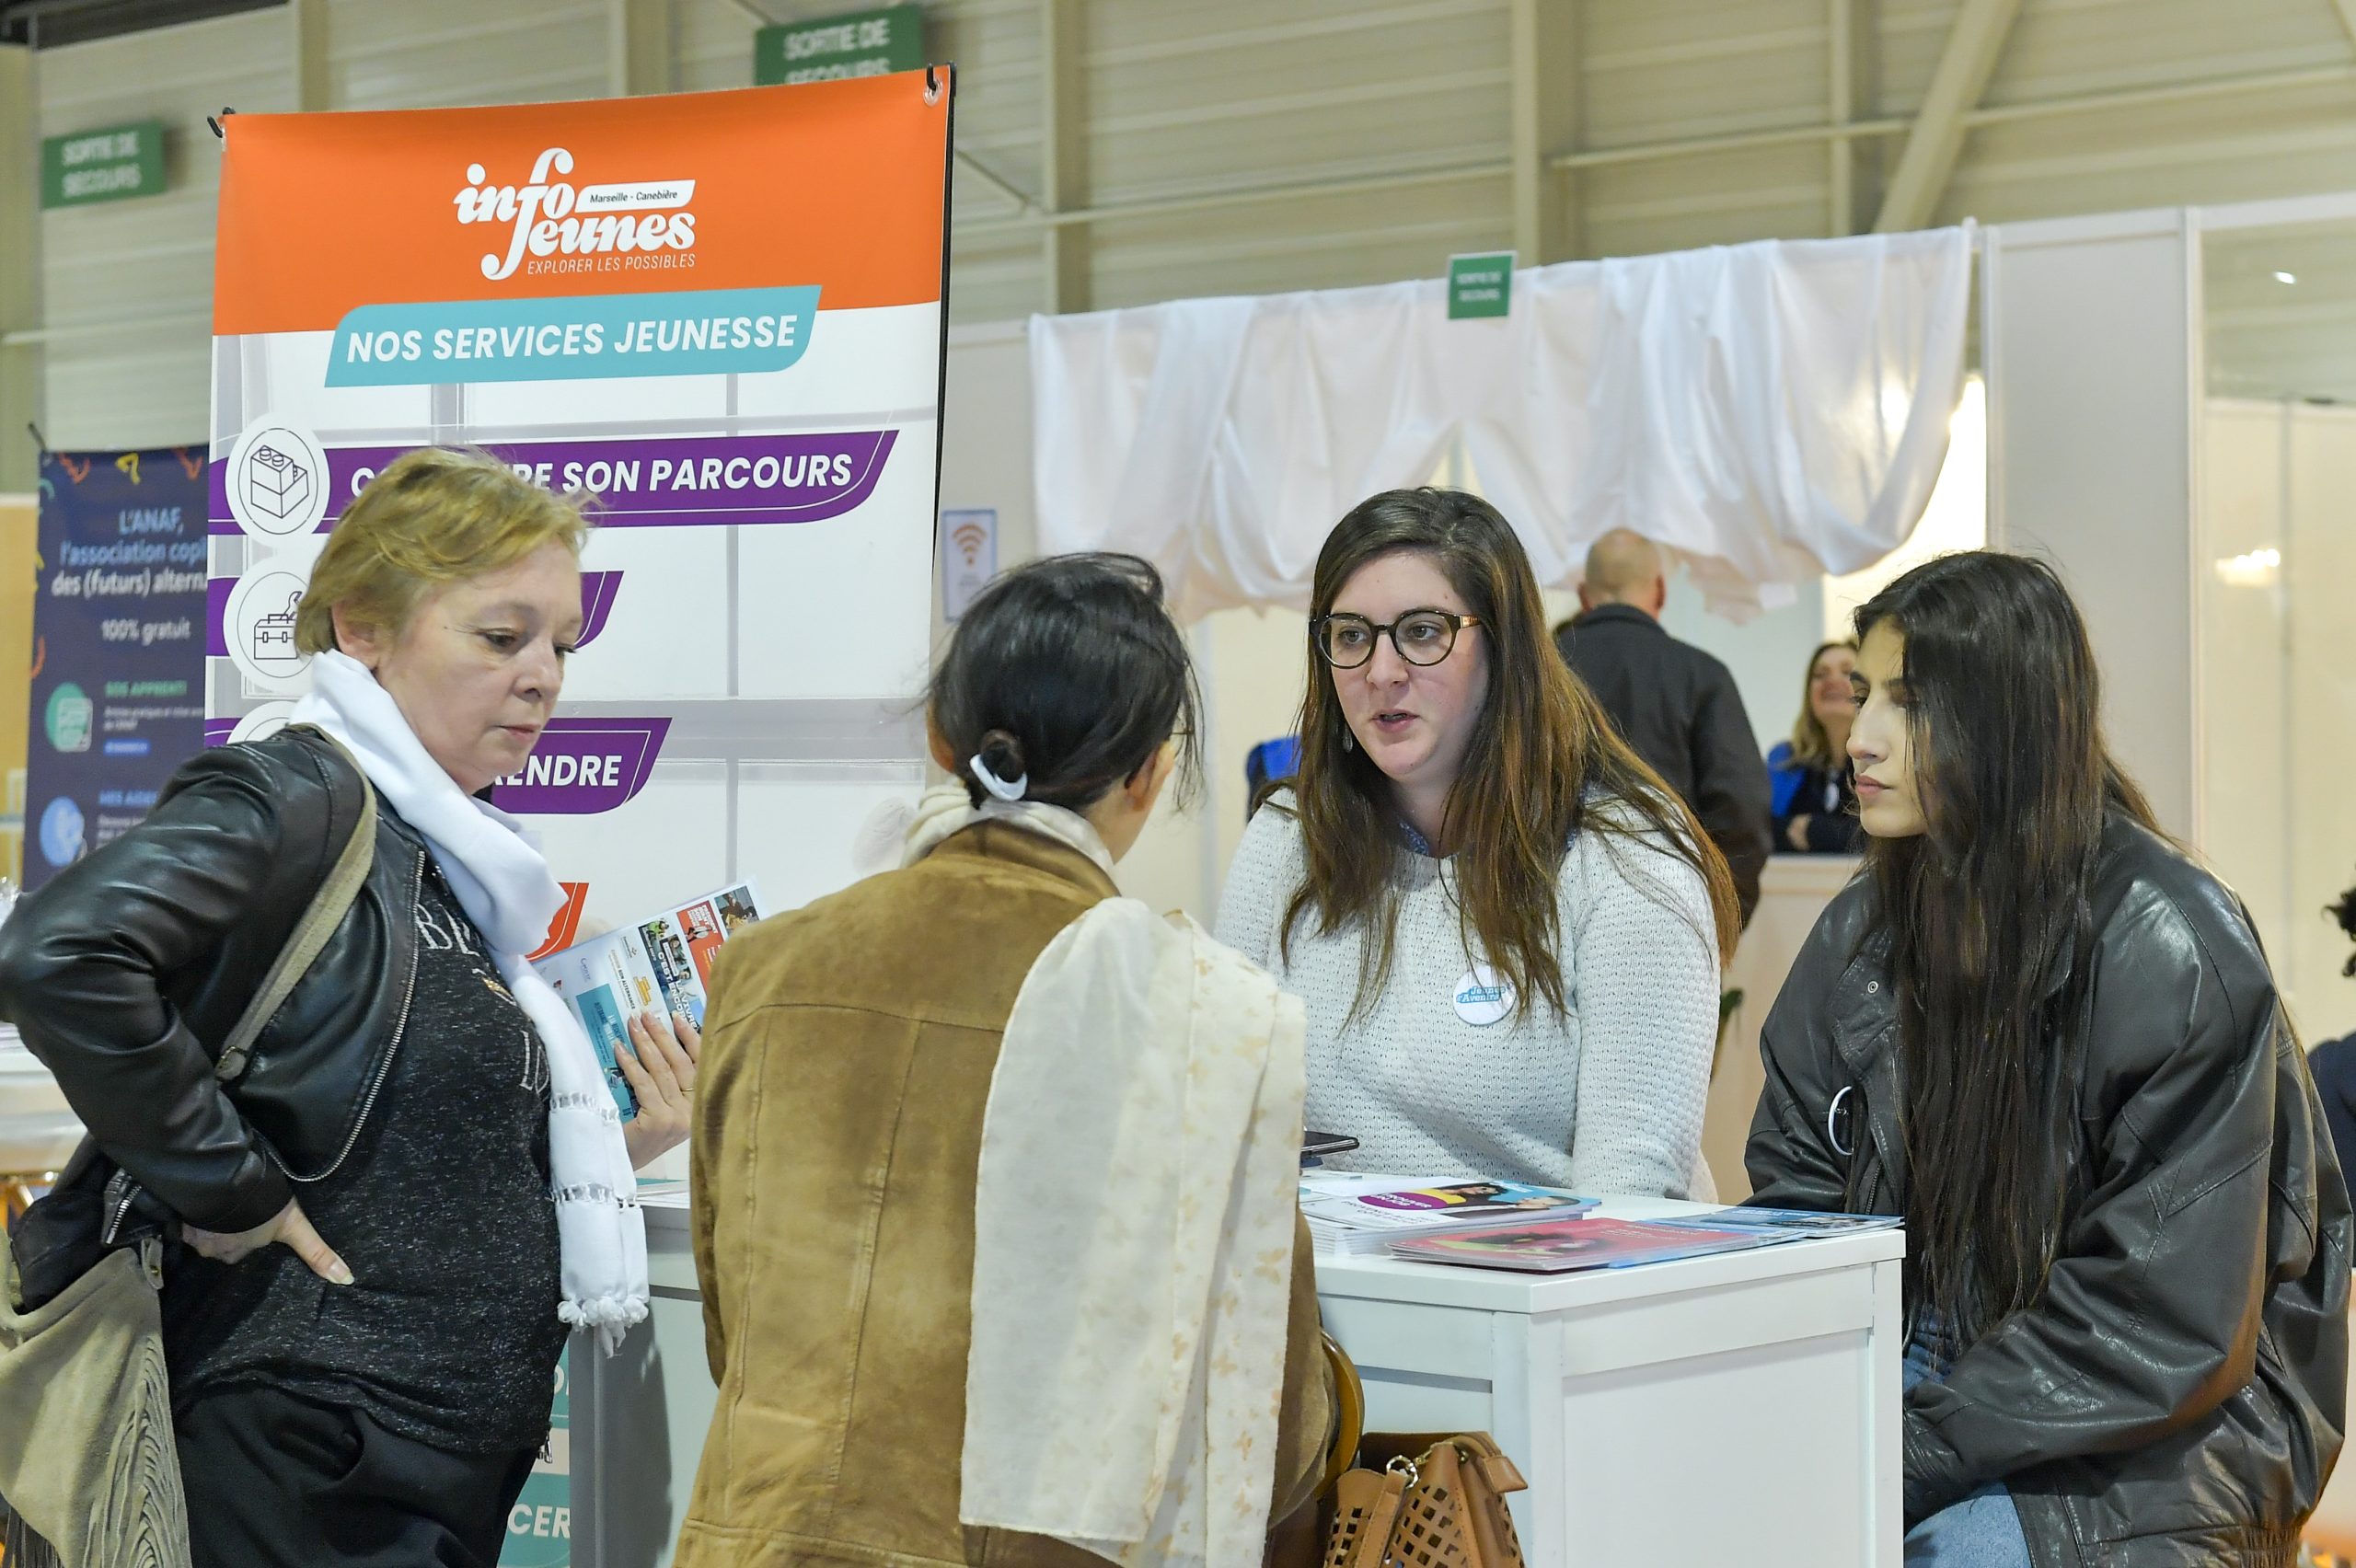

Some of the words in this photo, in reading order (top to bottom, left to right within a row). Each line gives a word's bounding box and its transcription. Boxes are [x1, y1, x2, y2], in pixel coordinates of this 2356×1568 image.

[784, 24, 856, 60] SORTIE
[860, 18, 890, 48] DE
[453, 147, 574, 225] info
[590, 192, 628, 203] Marseille
[636, 189, 677, 202] Canebière
[527, 258, 592, 275] EXPLORER
[597, 257, 620, 271] LES
[625, 253, 696, 270] POSSIBLES
[347, 330, 422, 363] NOS
[433, 323, 604, 360] SERVICES
[614, 314, 798, 353] JEUNESSE
[562, 460, 640, 492] SON
[649, 454, 852, 490] PARCOURS
[60, 539, 167, 566] l'association
[51, 571, 81, 596] des
[83, 567, 151, 599] (futurs)
[100, 618, 139, 641] 100%
[142, 617, 191, 646] gratuit
[494, 755, 622, 786] NDRE
